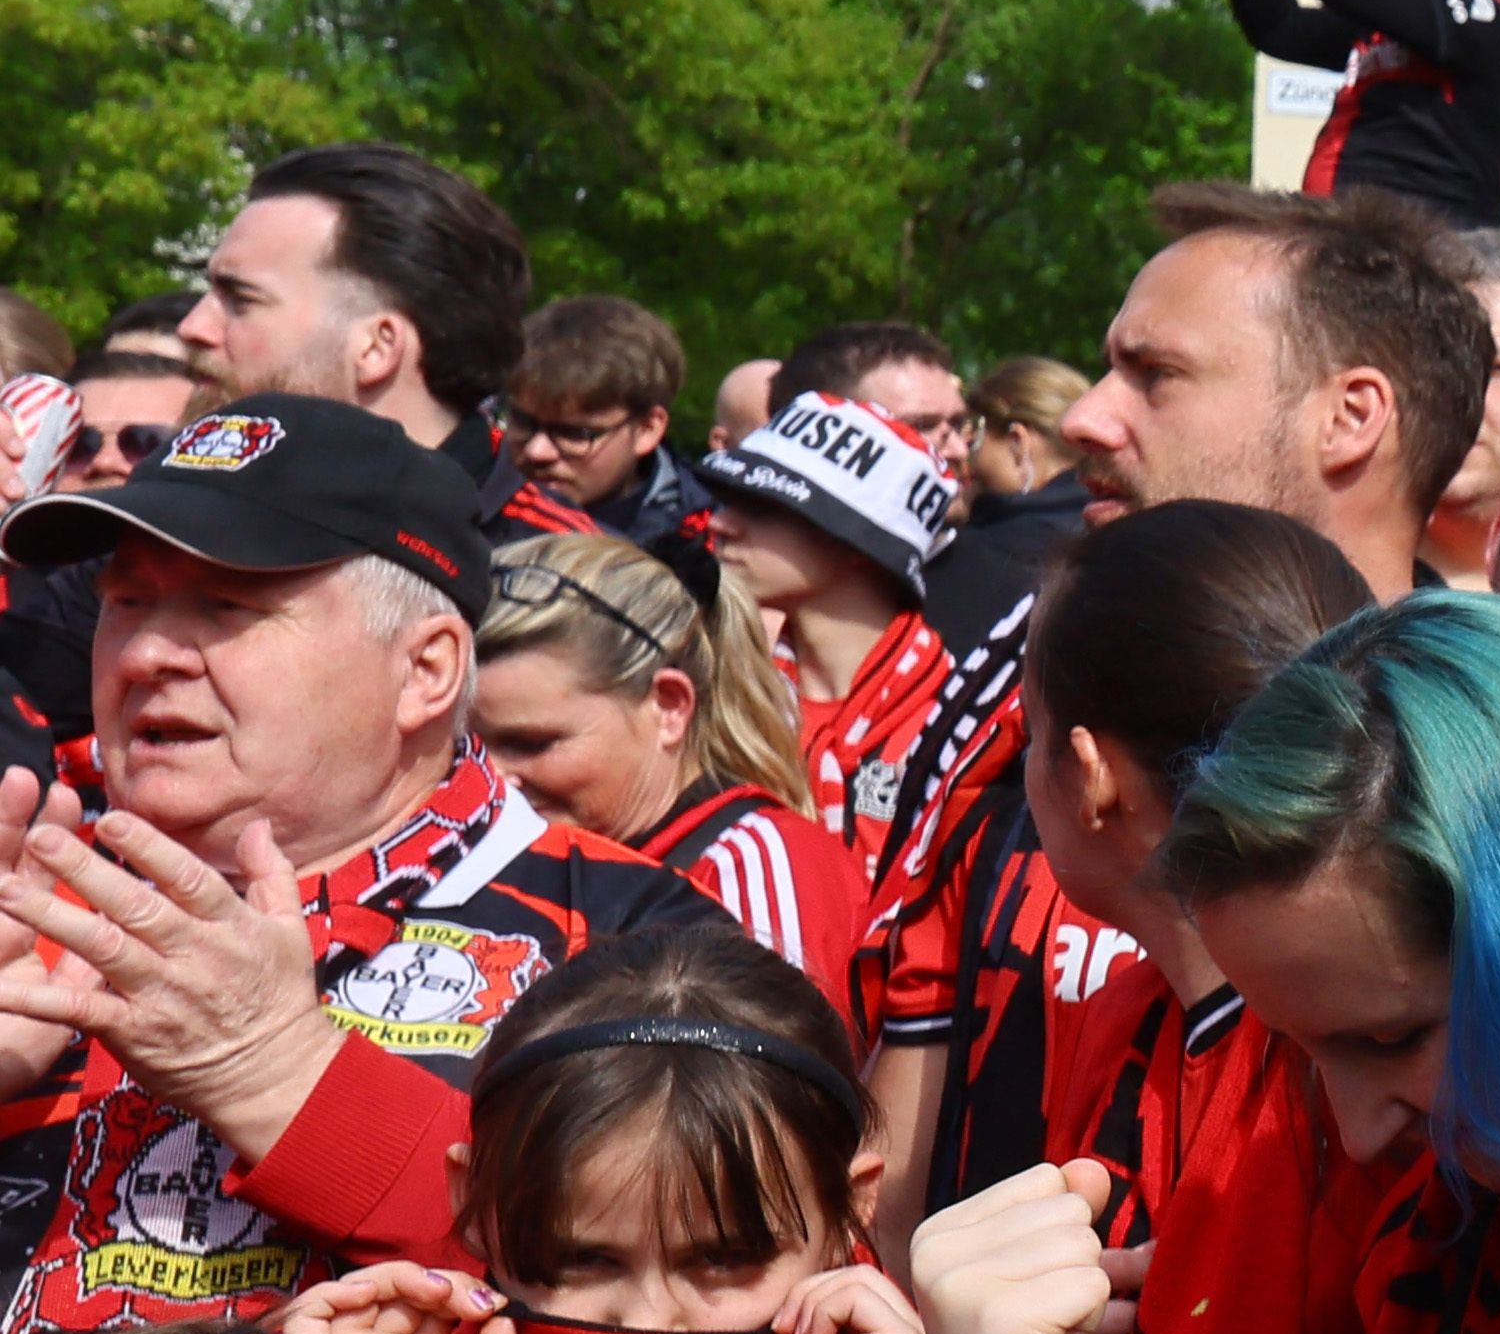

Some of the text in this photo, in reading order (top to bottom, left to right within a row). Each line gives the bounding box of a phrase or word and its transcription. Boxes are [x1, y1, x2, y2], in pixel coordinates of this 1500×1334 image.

[410, 924, 469, 956] 1904
[351, 964, 467, 996] BAYER
[328, 1011, 473, 1050] everkusen
[86, 1251, 294, 1292] Leverkusen
